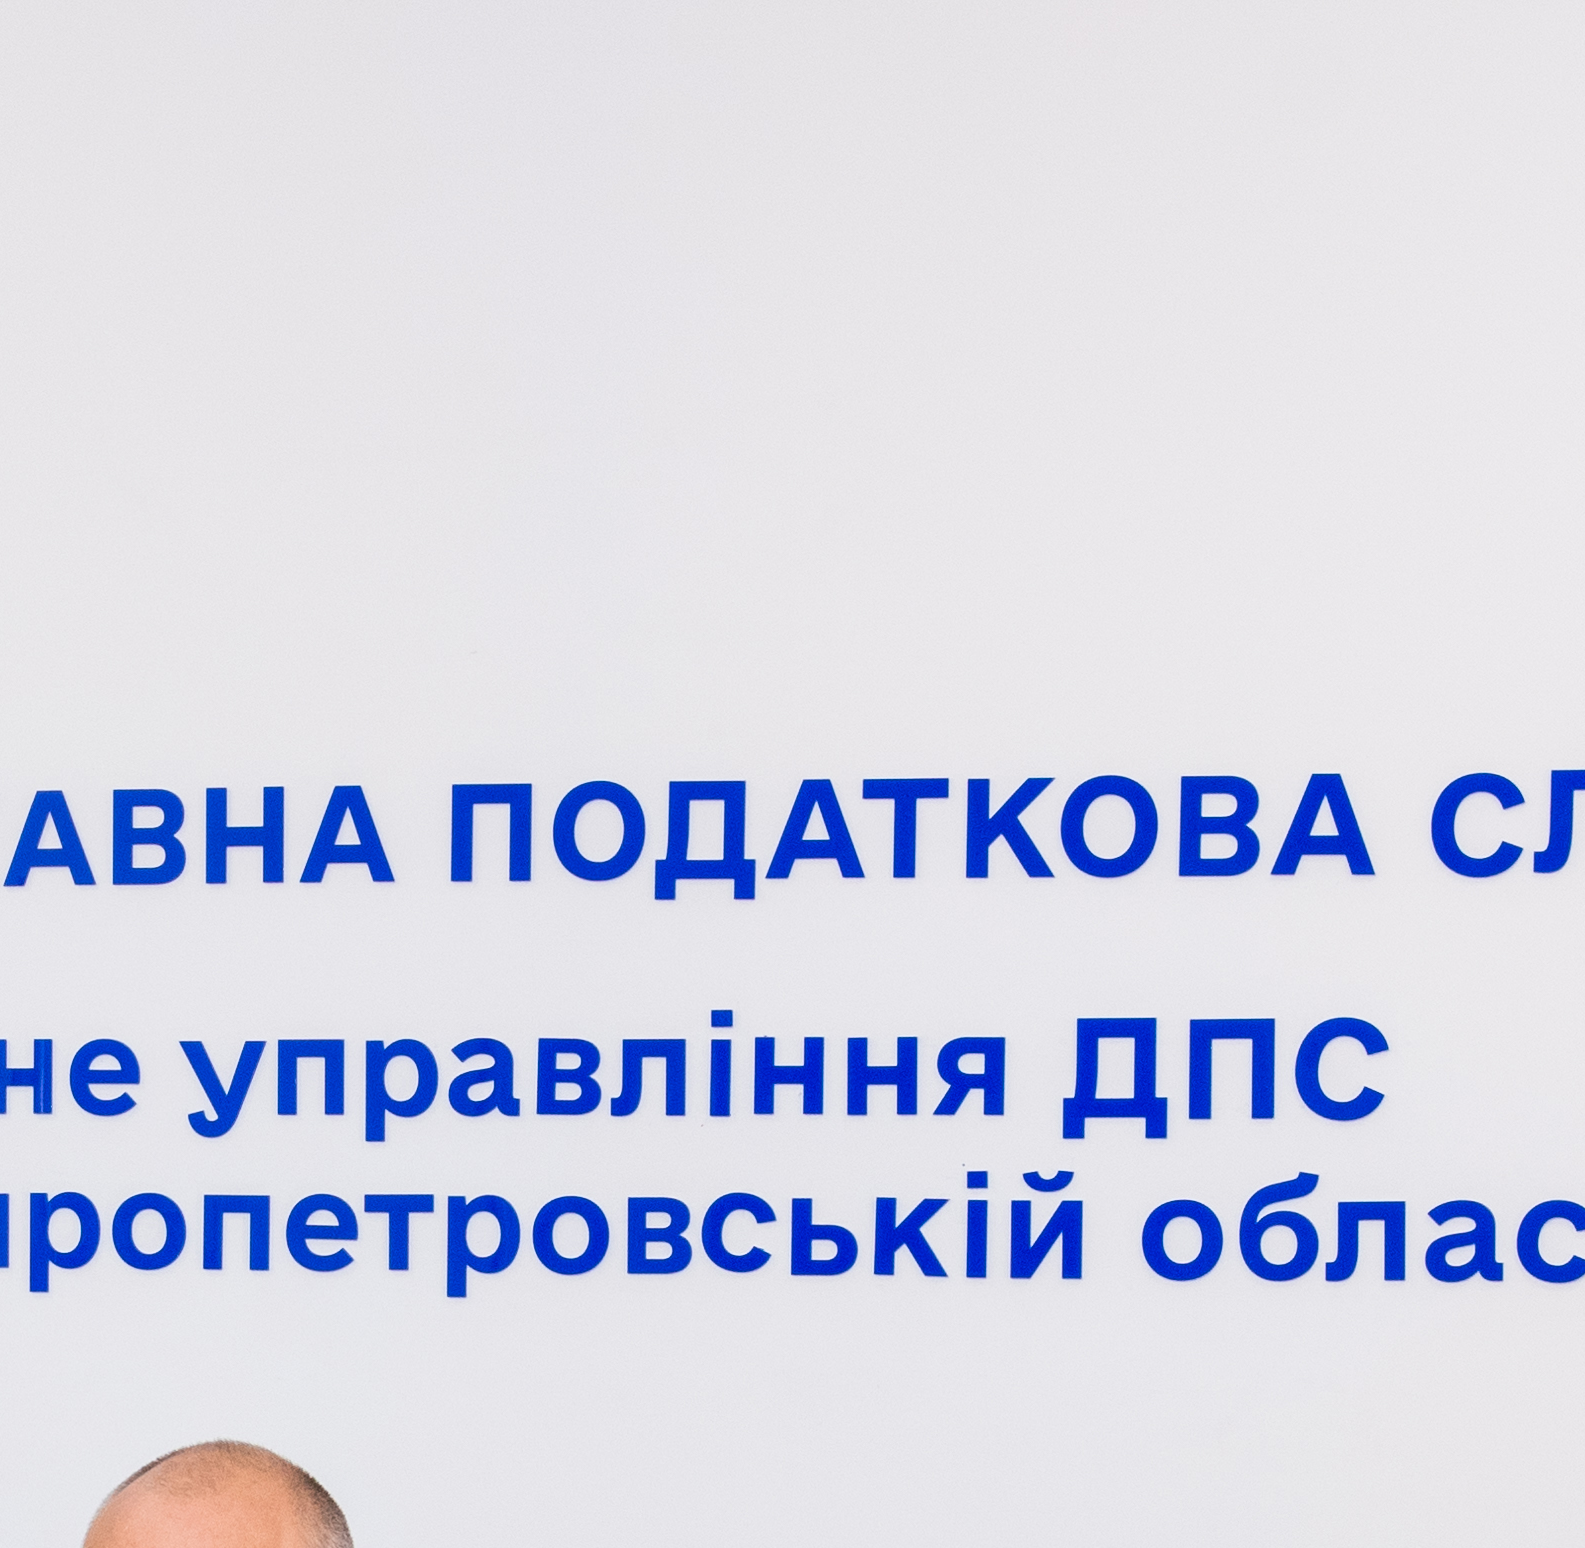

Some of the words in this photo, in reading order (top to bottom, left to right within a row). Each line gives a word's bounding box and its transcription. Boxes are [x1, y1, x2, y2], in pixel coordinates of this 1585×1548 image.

[451, 773, 1375, 900] ПОДАТКОВА
[180, 1010, 1006, 1142] управління
[1062, 1017, 1389, 1139] ДПС
